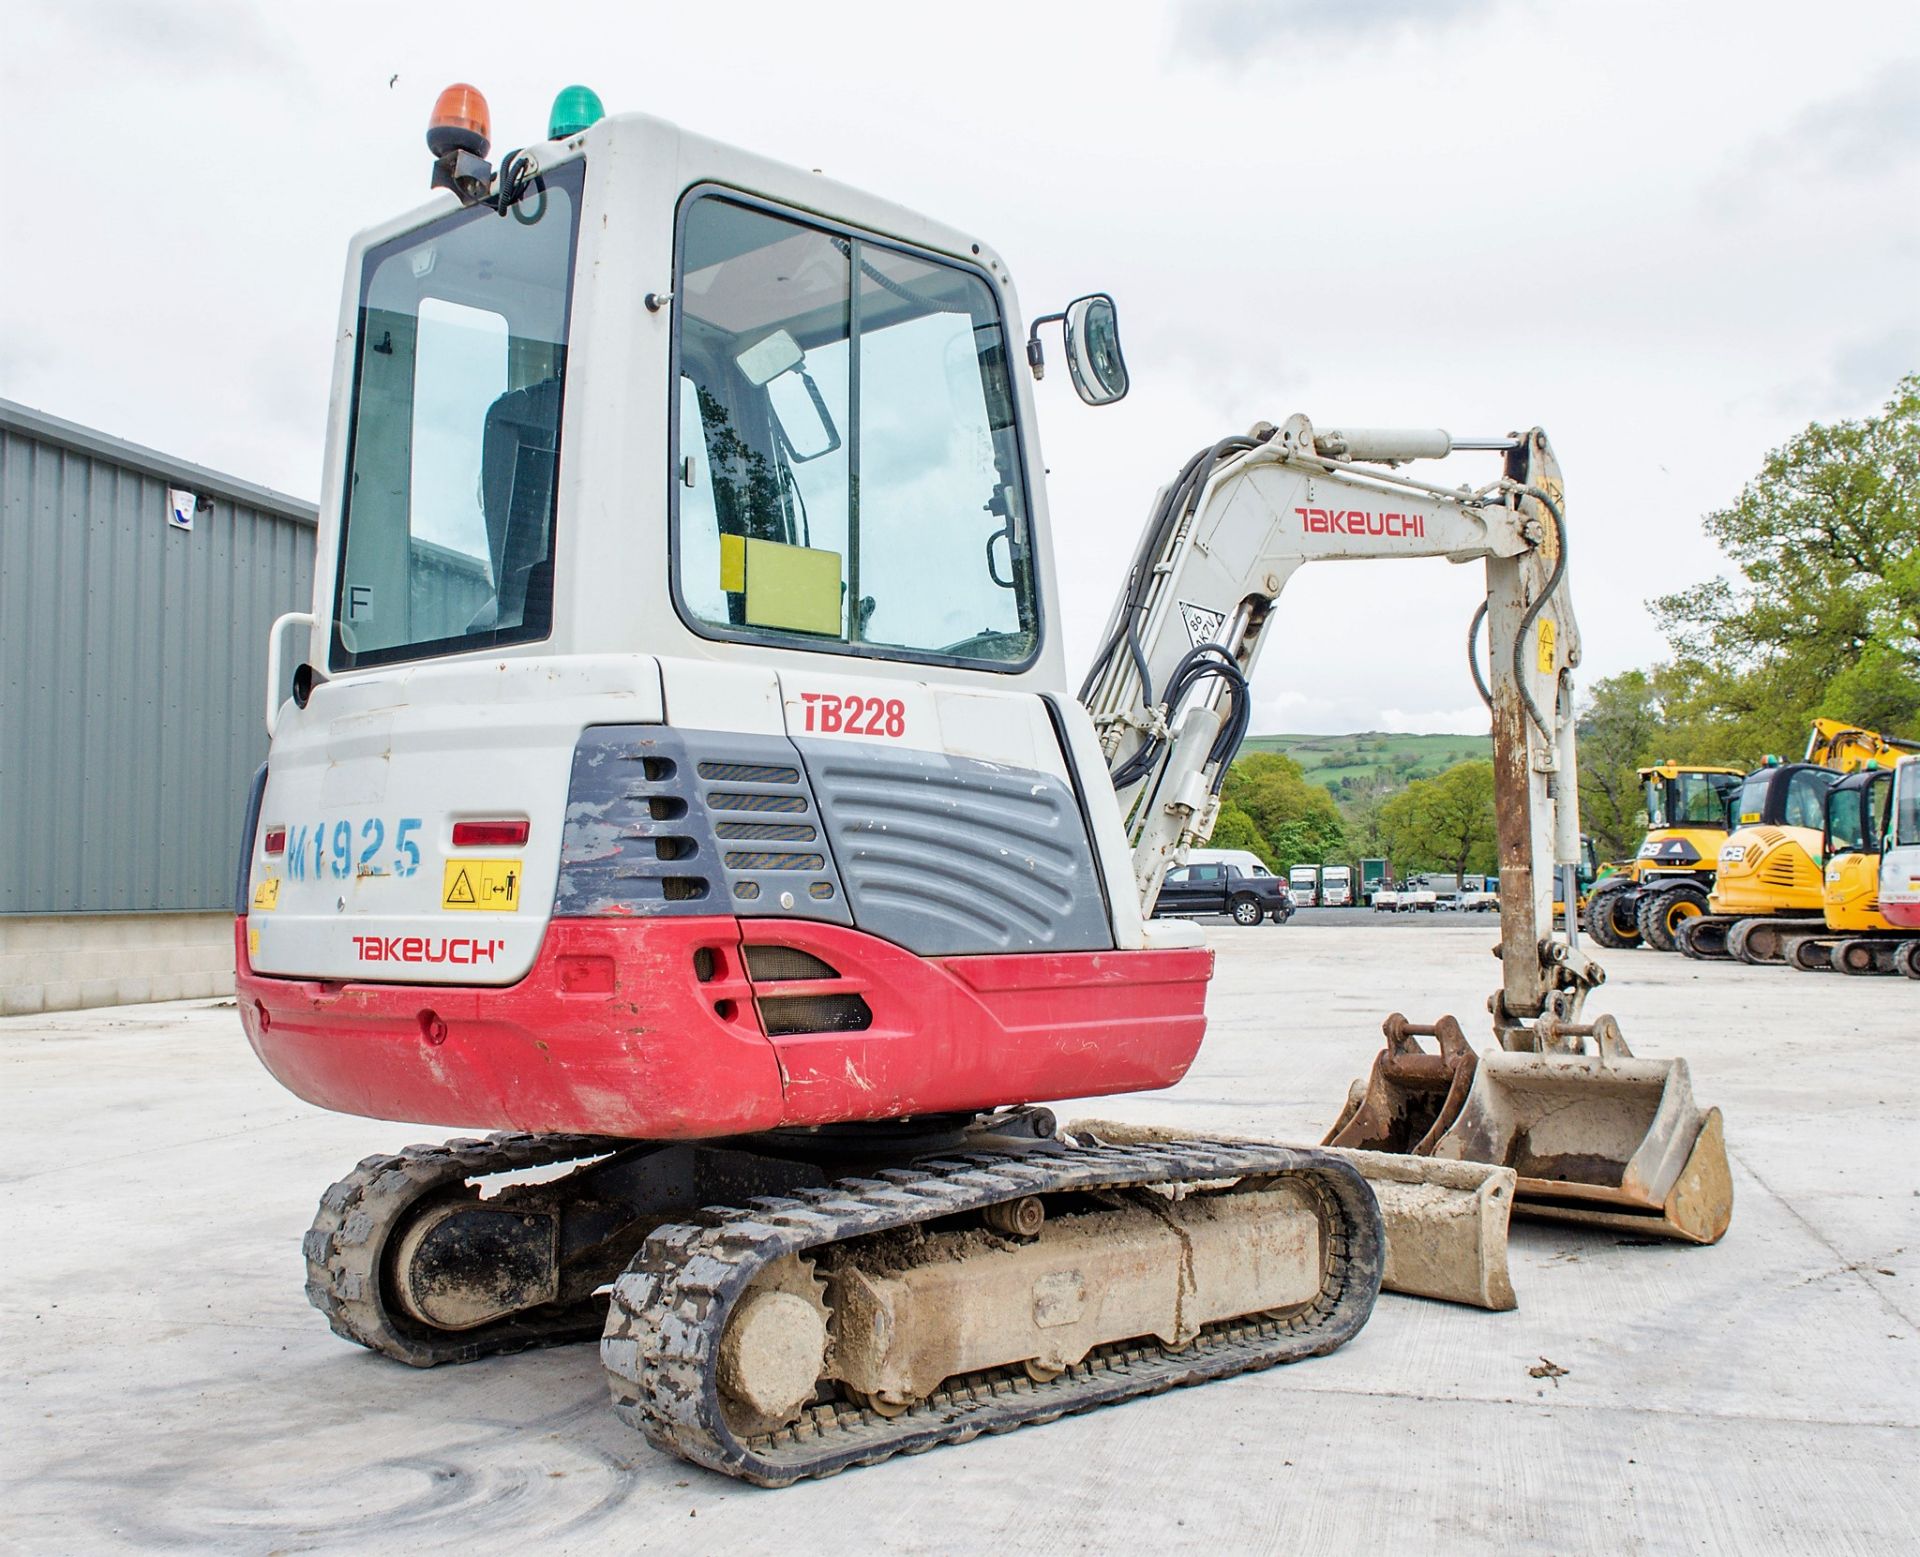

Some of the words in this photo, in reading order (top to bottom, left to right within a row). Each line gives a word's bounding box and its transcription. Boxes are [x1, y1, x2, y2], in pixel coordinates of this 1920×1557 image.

[350, 586, 371, 618] F
[1190, 613, 1202, 632] 86
[800, 693, 905, 737] TB228
[287, 818, 422, 881] M1925
[1639, 842, 1662, 856] CB
